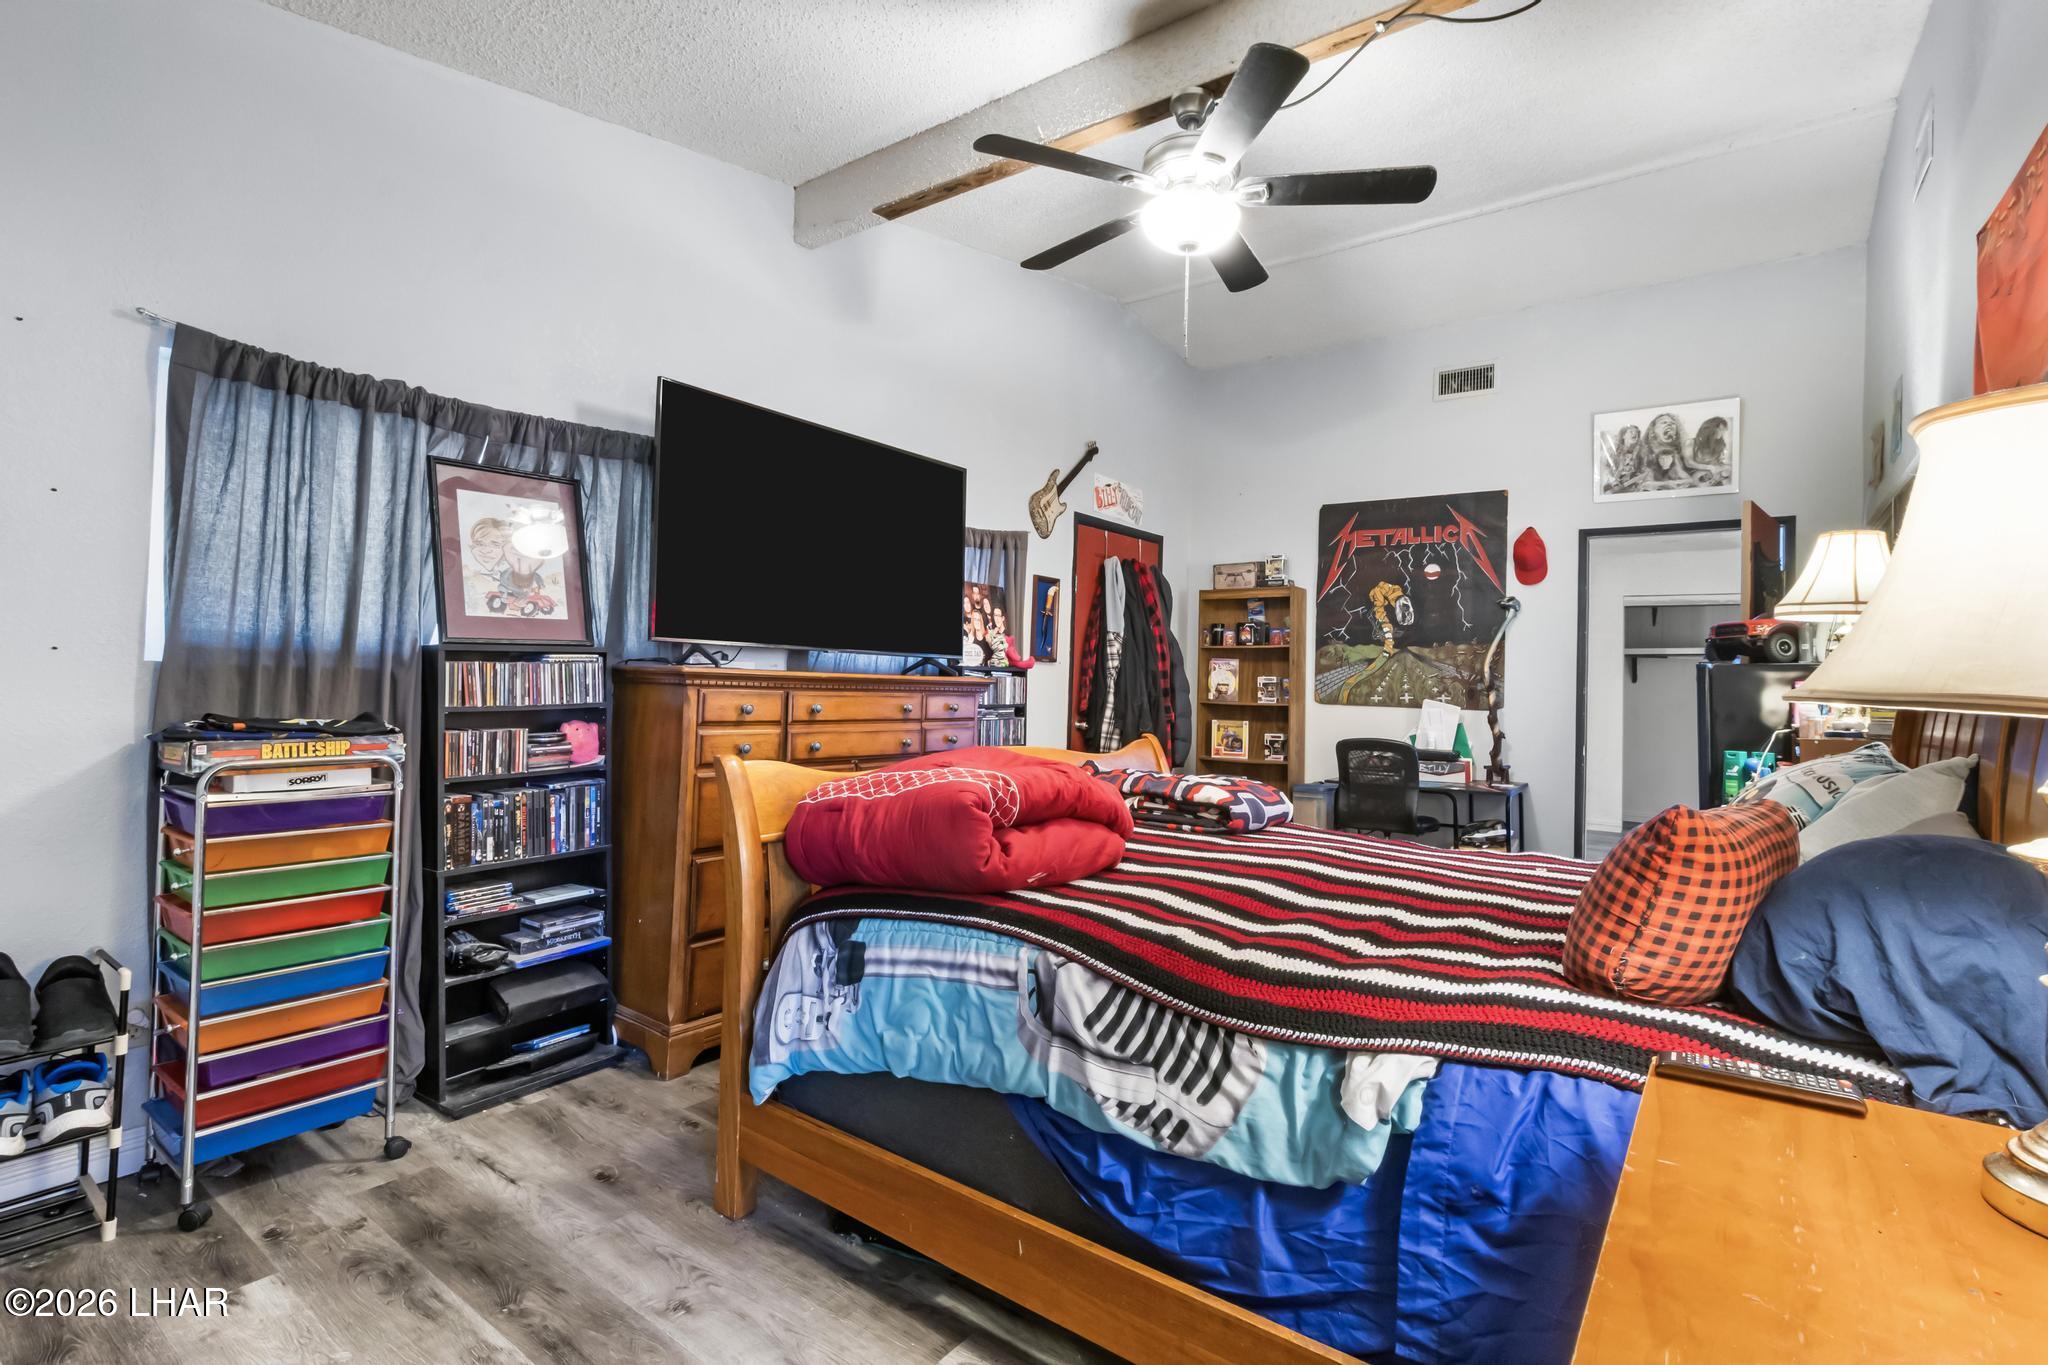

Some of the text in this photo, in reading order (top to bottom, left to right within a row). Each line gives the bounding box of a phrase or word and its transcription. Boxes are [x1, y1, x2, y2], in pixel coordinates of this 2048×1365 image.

[1317, 504, 1506, 603] METALLICA
[261, 740, 351, 759] BATTLESHIP
[1418, 763, 1450, 774] BILLY
[288, 774, 326, 786] SORRY!
[1812, 773, 1845, 799] USIC
